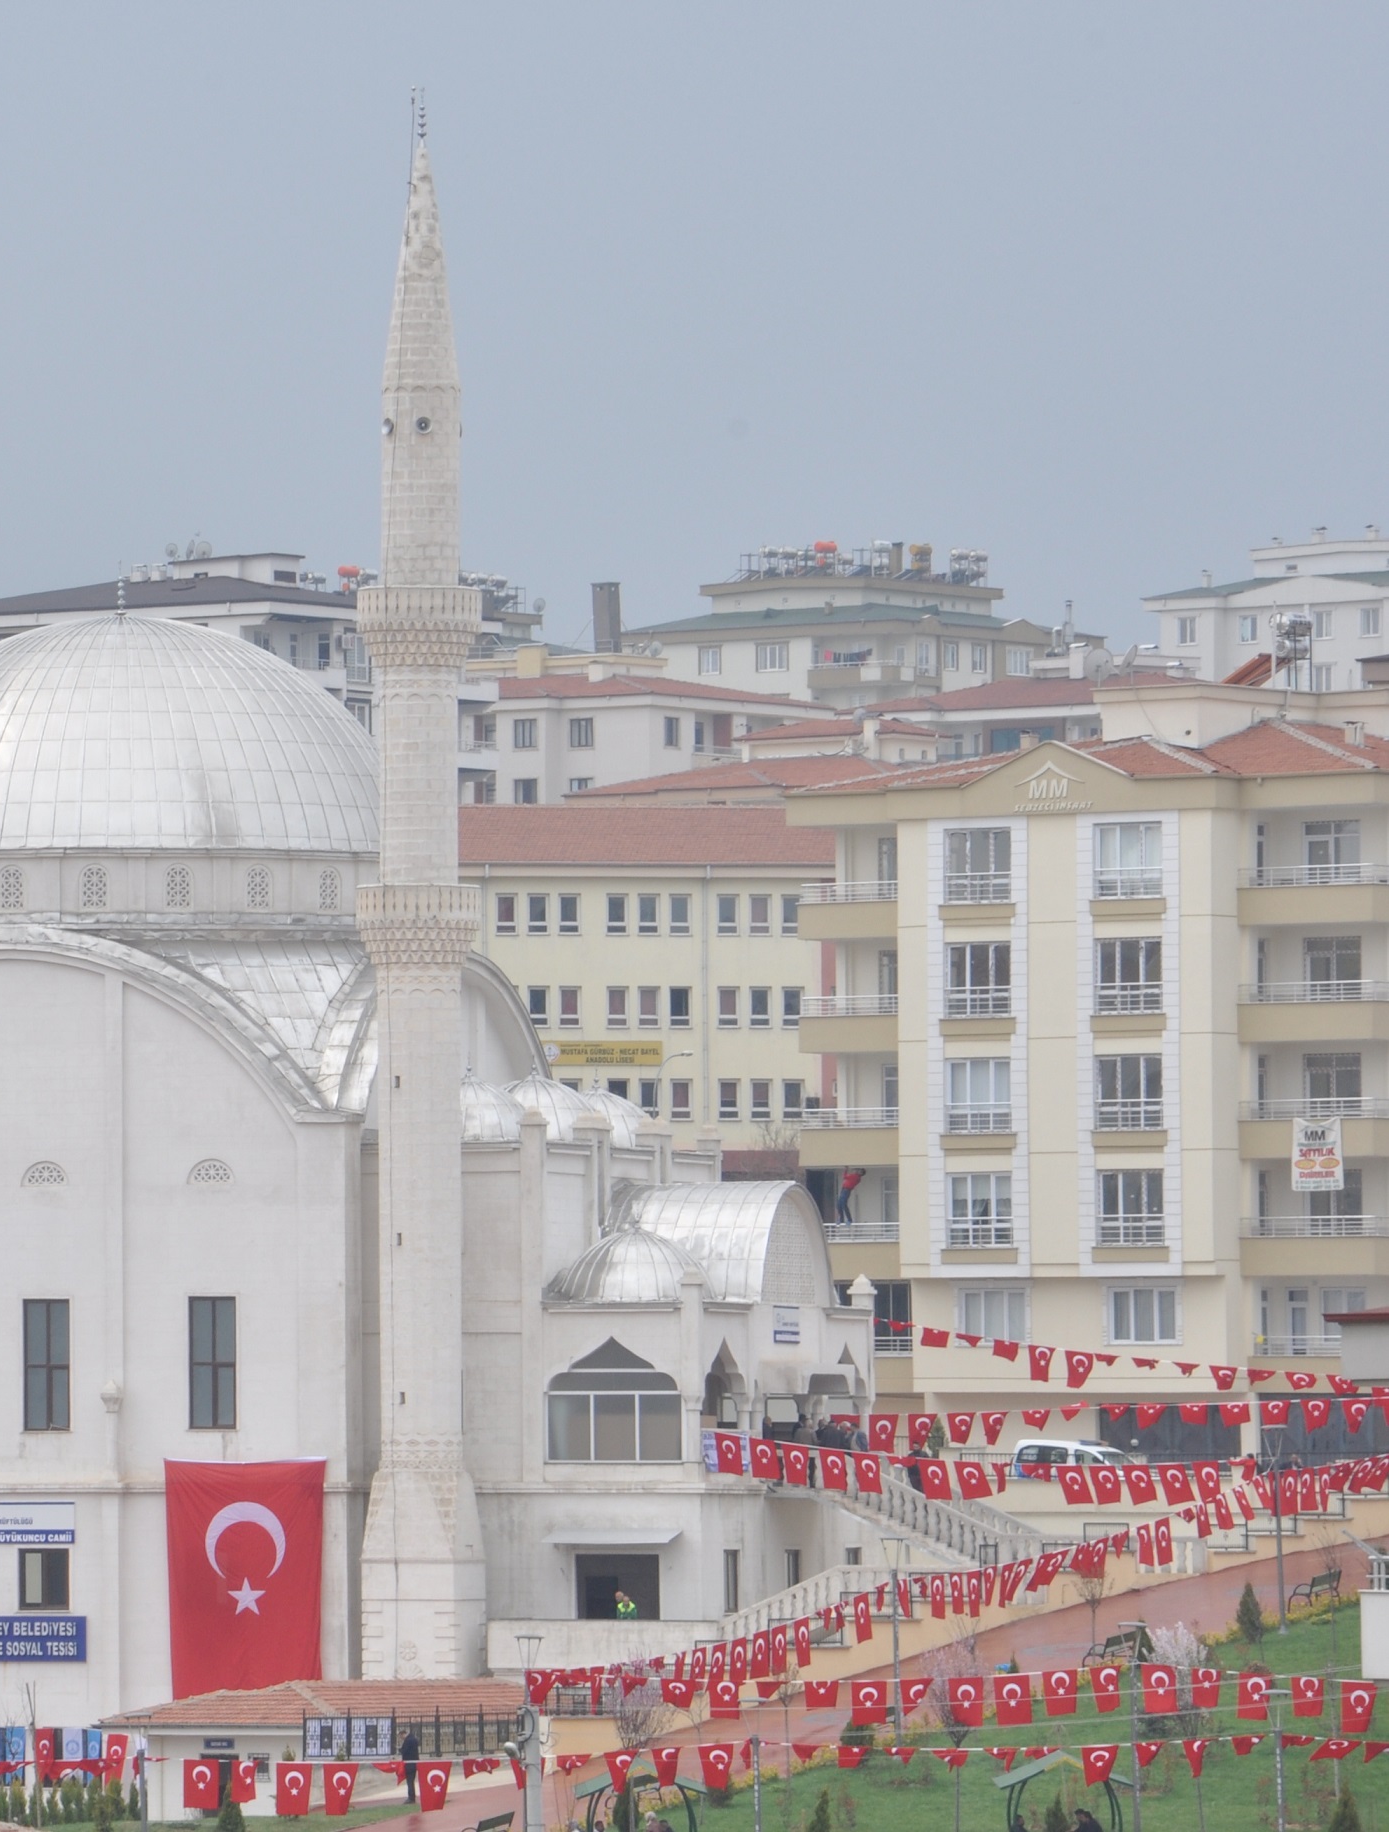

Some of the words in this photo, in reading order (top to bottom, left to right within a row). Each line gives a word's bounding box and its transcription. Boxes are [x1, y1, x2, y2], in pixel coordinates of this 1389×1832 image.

[1028, 778, 1068, 799] MM
[560, 1048, 589, 1056] MUSTAFA
[1305, 1130, 1326, 1142] MM
[48, 1531, 72, 1542] CAMİİ
[13, 1621, 76, 1636] BELEDİYESİ
[6, 1641, 43, 1656] SOSYAL
[46, 1641, 77, 1656] TESİSİ
